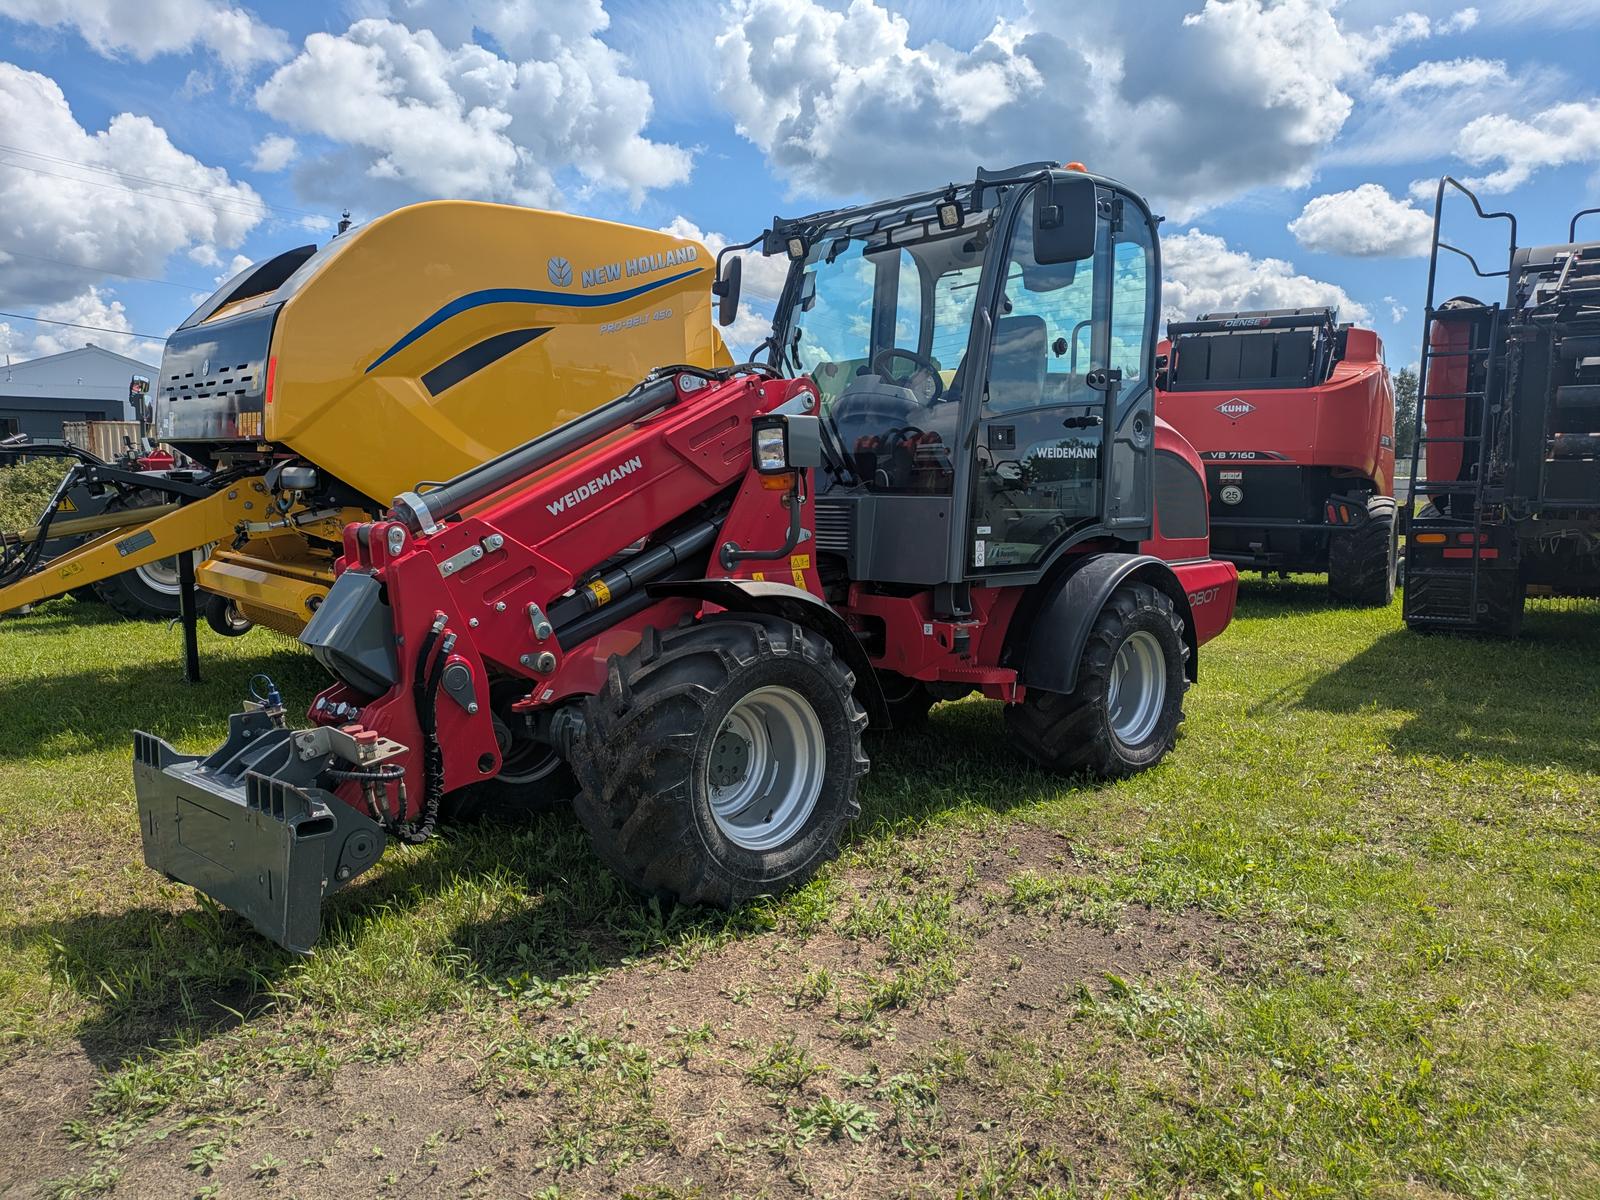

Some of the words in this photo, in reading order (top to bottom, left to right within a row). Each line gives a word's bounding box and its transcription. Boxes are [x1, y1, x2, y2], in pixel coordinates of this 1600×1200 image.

[582, 263, 621, 288] NEW
[625, 246, 698, 277] HOLLAND
[653, 309, 673, 321] 450
[1036, 447, 1097, 459] WEIDEMANN
[1210, 451, 1226, 459] VB
[1229, 451, 1256, 459] 7160
[546, 455, 643, 516] WEIDEMANN
[1225, 491, 1238, 499] 25
